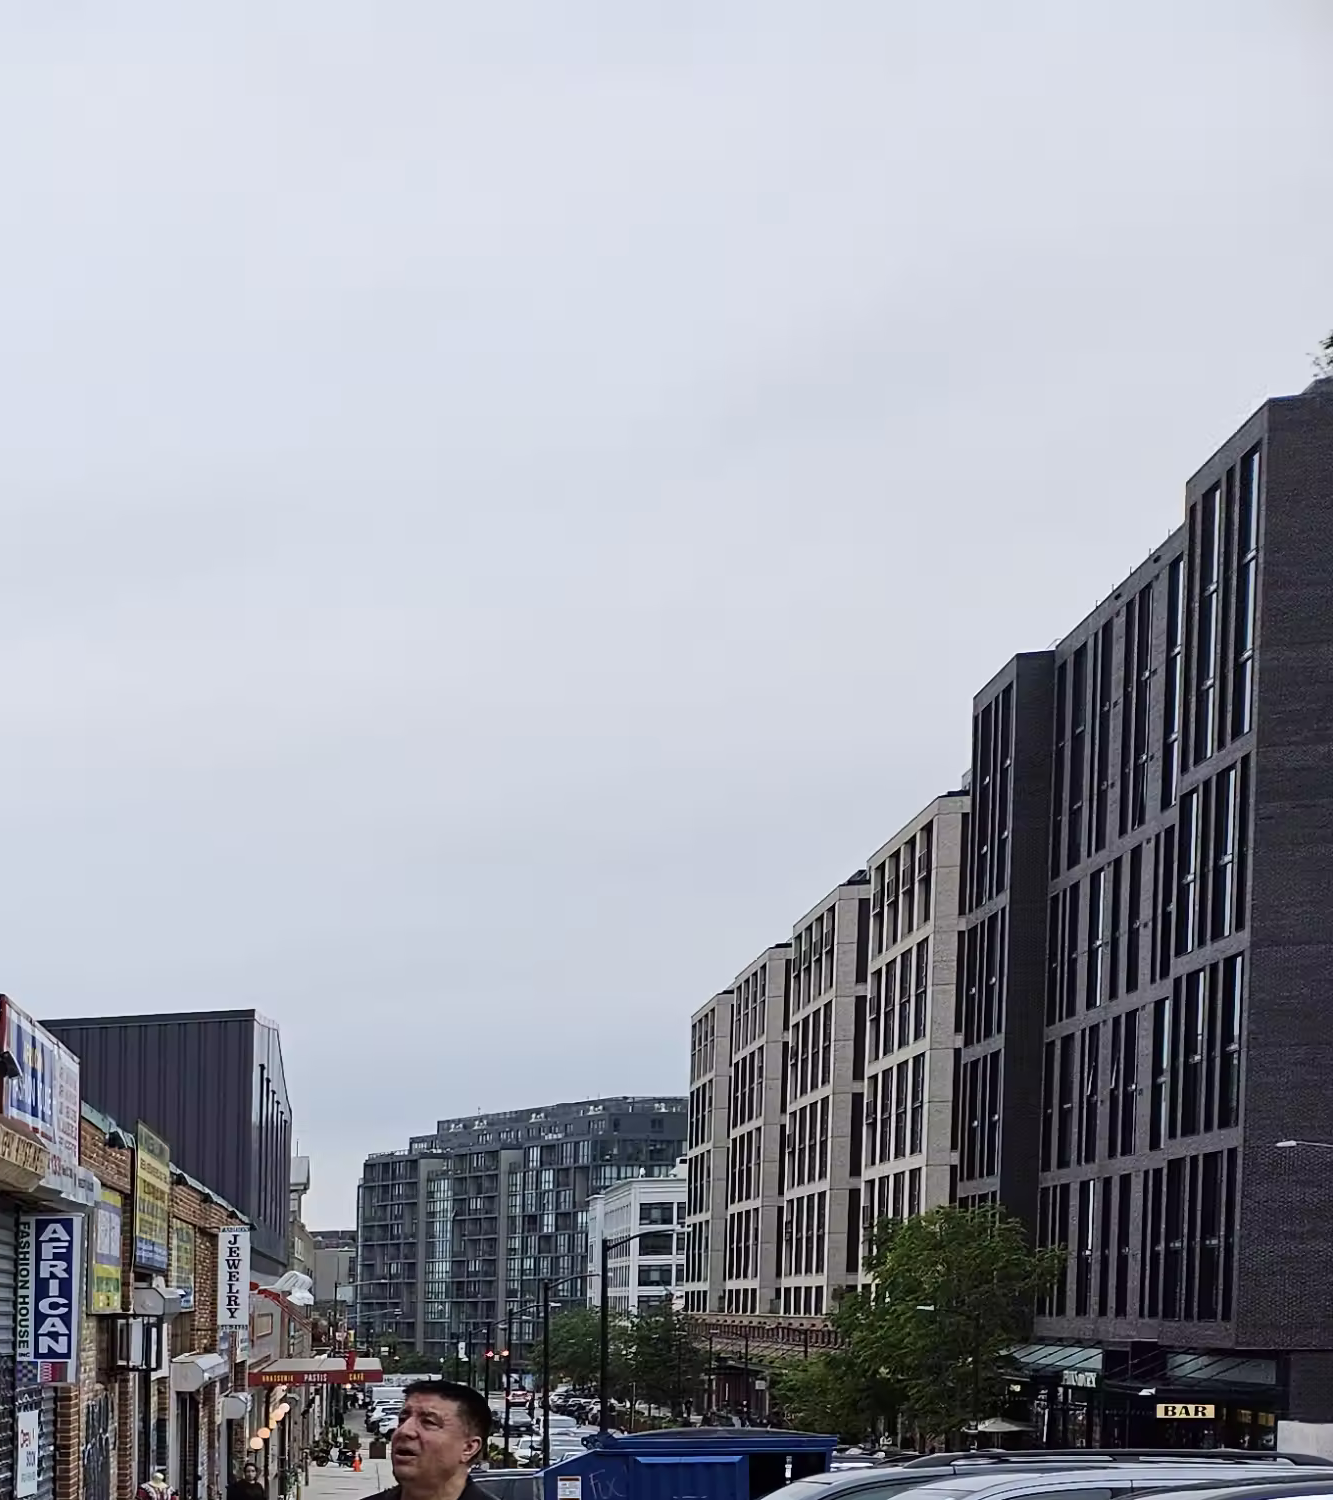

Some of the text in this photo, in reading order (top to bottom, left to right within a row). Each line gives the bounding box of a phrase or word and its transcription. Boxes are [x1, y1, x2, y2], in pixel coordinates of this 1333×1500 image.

[18, 1222, 31, 1290] FASHION
[225, 1234, 243, 1319] JEWELRY
[37, 1222, 71, 1354] AFRICAN
[18, 1293, 30, 1349] HOUSE
[304, 1374, 328, 1382] PASTIS
[1163, 1405, 1208, 1417] BAR
